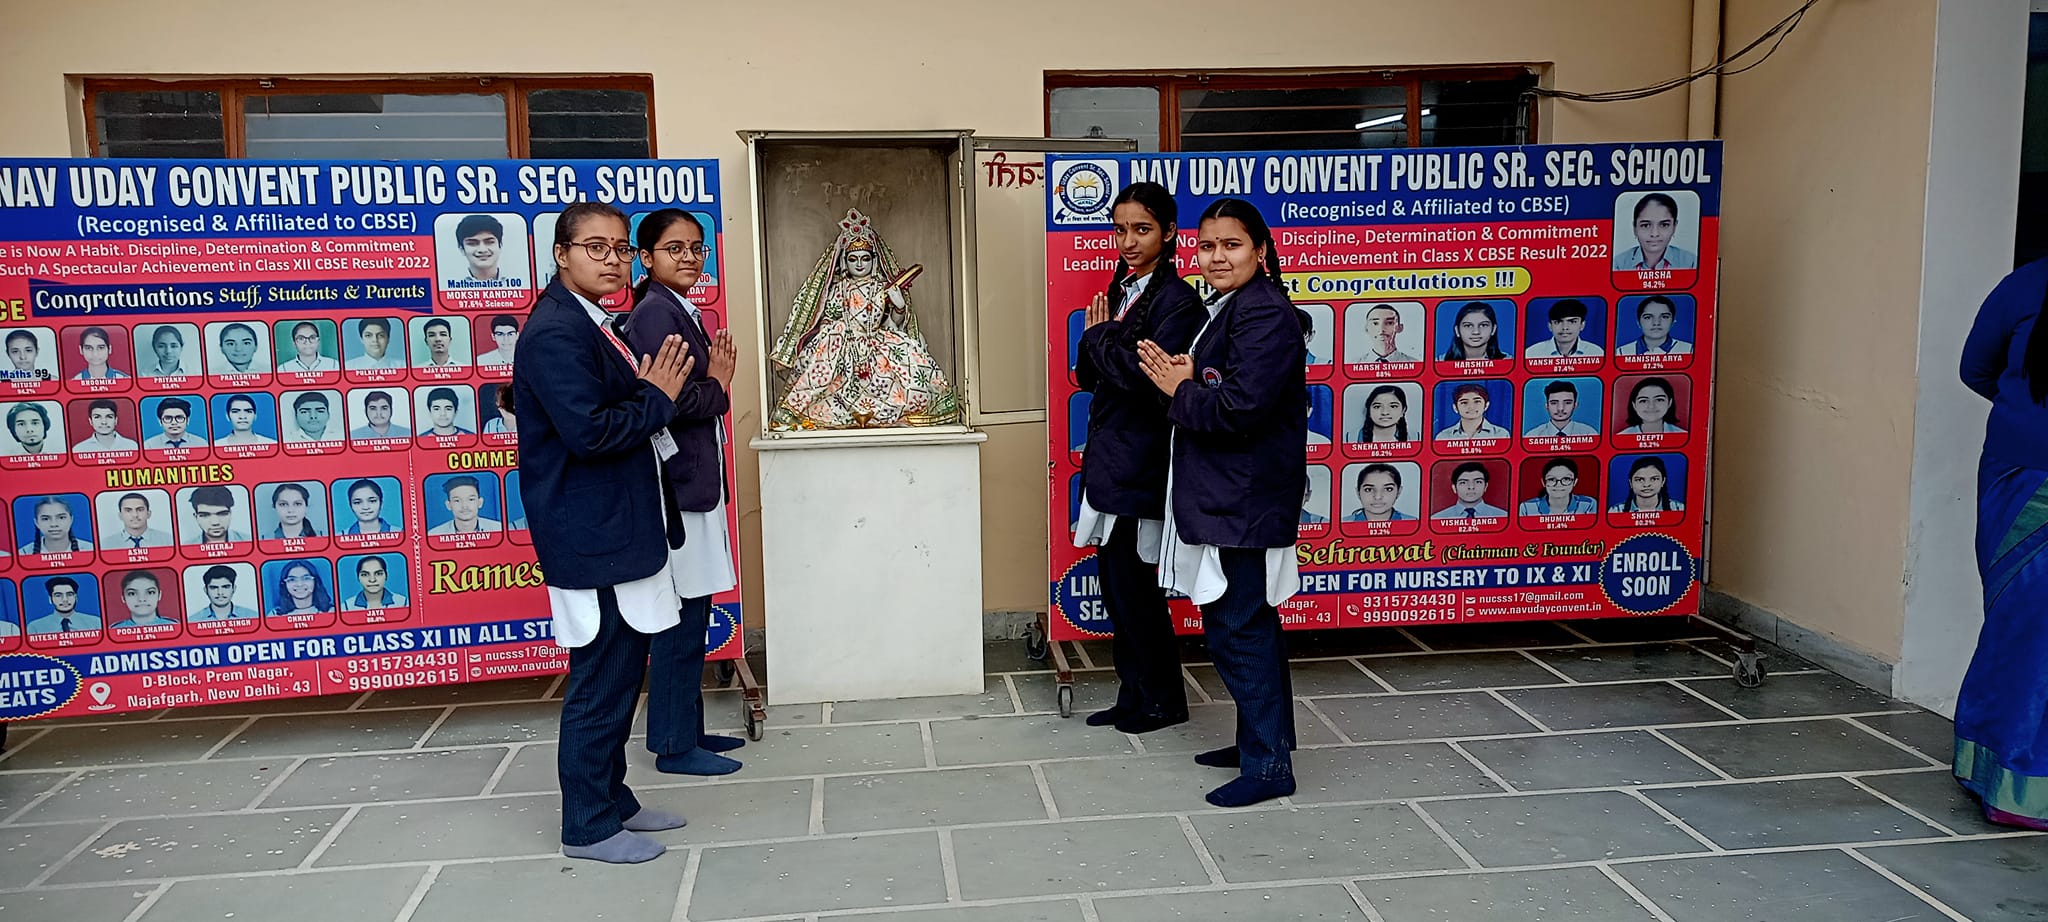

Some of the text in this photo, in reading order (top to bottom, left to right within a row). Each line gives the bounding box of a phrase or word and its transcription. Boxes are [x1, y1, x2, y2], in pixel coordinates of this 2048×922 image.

[1131, 157, 1181, 195] NAV
[1190, 158, 1255, 195] UDAY
[1265, 155, 1382, 193] CONVENT
[1391, 153, 1483, 190] PUBLIC
[1493, 152, 1534, 188] SR.
[1545, 151, 1600, 187] SEC.
[1610, 147, 1710, 185] SCHOOL
[0, 166, 713, 207] NAV UDAY CONVENT PUBLIC SR. SEC. SCHOOL
[1282, 195, 1569, 222] (Recognised & Affiliated to CBSE)
[78, 212, 416, 236] (Recognised & Affiliated to CBSE)
[1075, 225, 1598, 249] Excell Discipline, Determination & Commitment
[11, 246, 22, 257] is
[27, 246, 60, 257] Now
[66, 245, 76, 256] A
[81, 244, 123, 256] Habit.
[129, 243, 201, 257] Discipline,
[206, 241, 306, 254] Determination
[311, 241, 322, 252] &
[326, 240, 414, 252] Commitment
[1298, 251, 1398, 265] Achievement
[1404, 250, 1416, 263] in
[1422, 249, 1459, 262] Class
[1464, 249, 1473, 261] X
[1479, 247, 1515, 260] CBSE
[1521, 246, 1566, 259] Result
[1571, 245, 1607, 258] 2022
[0, 257, 429, 277] Such A Spectacular Achievement in Class XII CBSE Result 2022
[447, 278, 522, 288] Mathematics 100
[1638, 271, 1671, 282] VARSHA
[1307, 275, 1487, 297] Congratulations
[1494, 271, 1514, 288] !!!
[36, 284, 424, 312] Congratulations Staff, Students & Parents
[444, 289, 524, 299] MOKSH KANDPAL
[459, 300, 483, 308] 97.6%
[1553, 356, 1599, 367] SRIVASTAVA
[1624, 355, 1661, 363] MANISHA
[1352, 362, 1415, 372] HARSH SIWHAN
[0, 369, 32, 379] Maths
[1529, 435, 1593, 447] SACHIN SHARMA
[1634, 433, 1663, 443] DEEPTI
[1351, 441, 1411, 451] SNEHA MISHRA
[1447, 440, 1496, 450] AMAN YADAV
[448, 451, 518, 469] COMME
[106, 464, 234, 487] HUMANITIES
[1440, 518, 1469, 527] VISHAL
[1539, 515, 1575, 523] BHUMIKA
[1630, 512, 1660, 520] SHIKHA
[1368, 522, 1391, 531] RINKY
[439, 533, 490, 543] HARSH YADAV
[41, 553, 72, 561] MAHIMA
[128, 547, 149, 555] ASHU
[1297, 537, 1606, 567] Sehrawat (Chairman & Founder)
[1609, 550, 1681, 572] ENROLL
[430, 560, 544, 594] Rames
[1299, 565, 1590, 594] PEN FOR NURSERY TO IX & XI
[1622, 576, 1670, 596] SOON
[1279, 597, 1317, 610] Nagar,
[1364, 594, 1455, 607] 9315734430
[1479, 592, 1584, 605] nucsss17@gmail.com
[366, 609, 385, 617] JAYA
[1479, 602, 1601, 615] www.navudayconvent.in
[1317, 612, 1330, 622] 43
[1364, 609, 1455, 622] 9990092615
[116, 625, 174, 635] POOJA SHARMA
[197, 619, 251, 629] ANURAG SINGH
[29, 630, 100, 641] RITESH SEHRAWAT
[90, 647, 221, 677] ADMISSION
[228, 643, 285, 663] OPEN
[294, 639, 336, 657] FOR
[344, 632, 414, 657] CLASS
[421, 630, 441, 647] XI
[450, 627, 470, 645] IN
[479, 624, 517, 642] ALL
[348, 652, 458, 673] 9315734430
[0, 668, 65, 689] MITED
[143, 667, 293, 687] D-Block, Prem Nagar,
[349, 667, 458, 690] 9990092615
[128, 681, 310, 708] Najafgarh, New Delhi 43
